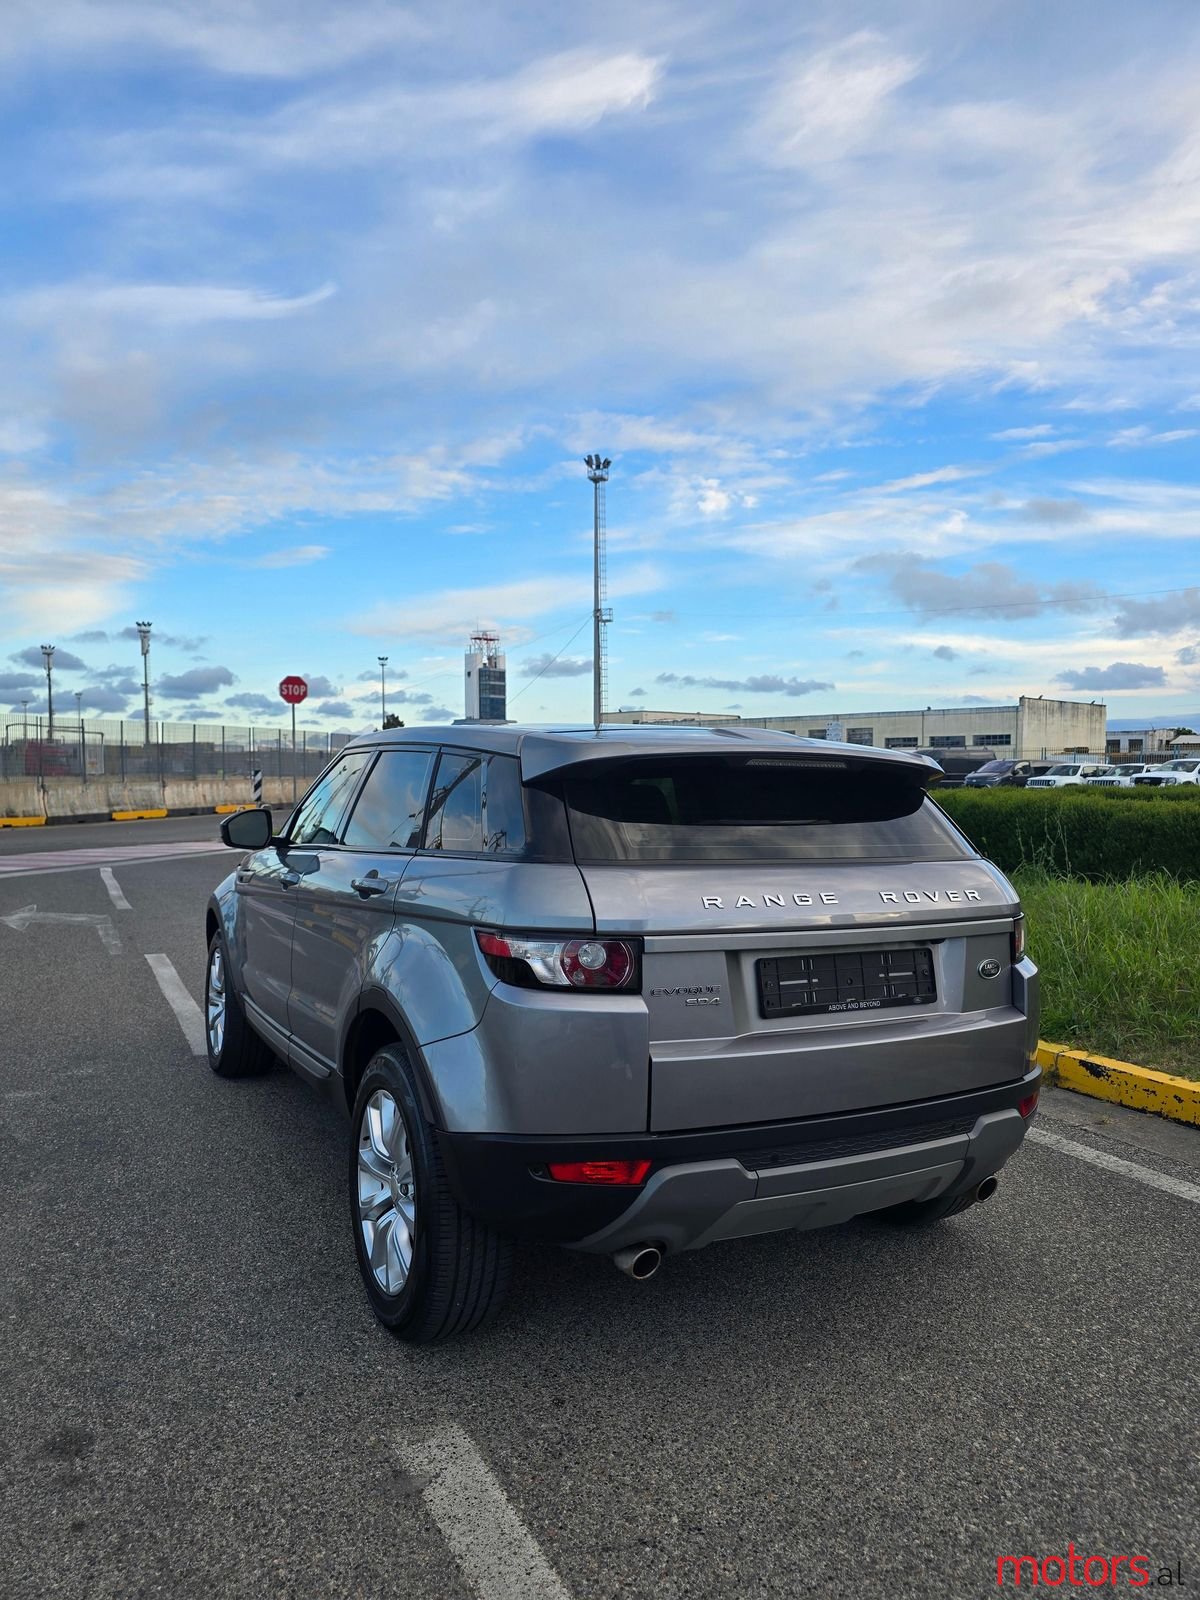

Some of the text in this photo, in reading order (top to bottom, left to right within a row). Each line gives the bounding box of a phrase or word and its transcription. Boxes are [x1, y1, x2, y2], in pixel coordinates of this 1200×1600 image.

[281, 684, 306, 696] STOP
[701, 889, 981, 909] RANGE ROVER
[650, 984, 721, 998] EVOQUE
[685, 997, 721, 1007] SD4
[828, 1000, 881, 1011] ABOVE AND BEYOND
